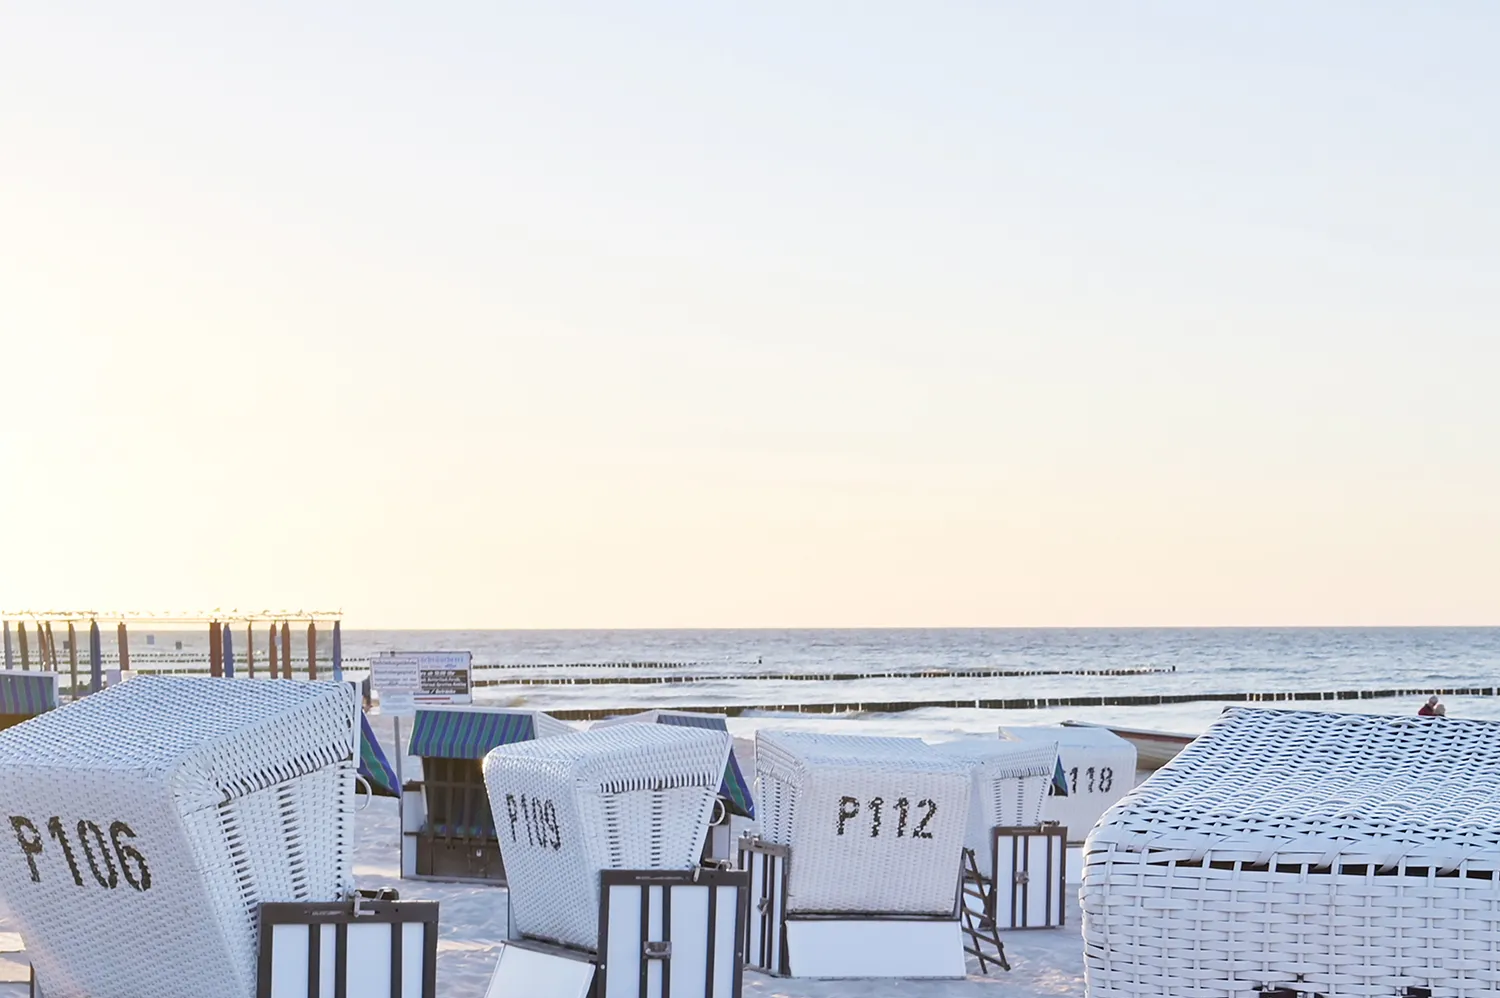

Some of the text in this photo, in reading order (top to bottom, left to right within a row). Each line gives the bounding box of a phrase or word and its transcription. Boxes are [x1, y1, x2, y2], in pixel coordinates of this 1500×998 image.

[1063, 766, 1114, 794] 118
[506, 794, 561, 851] P109
[835, 795, 939, 839] P112
[8, 814, 152, 893] P106
